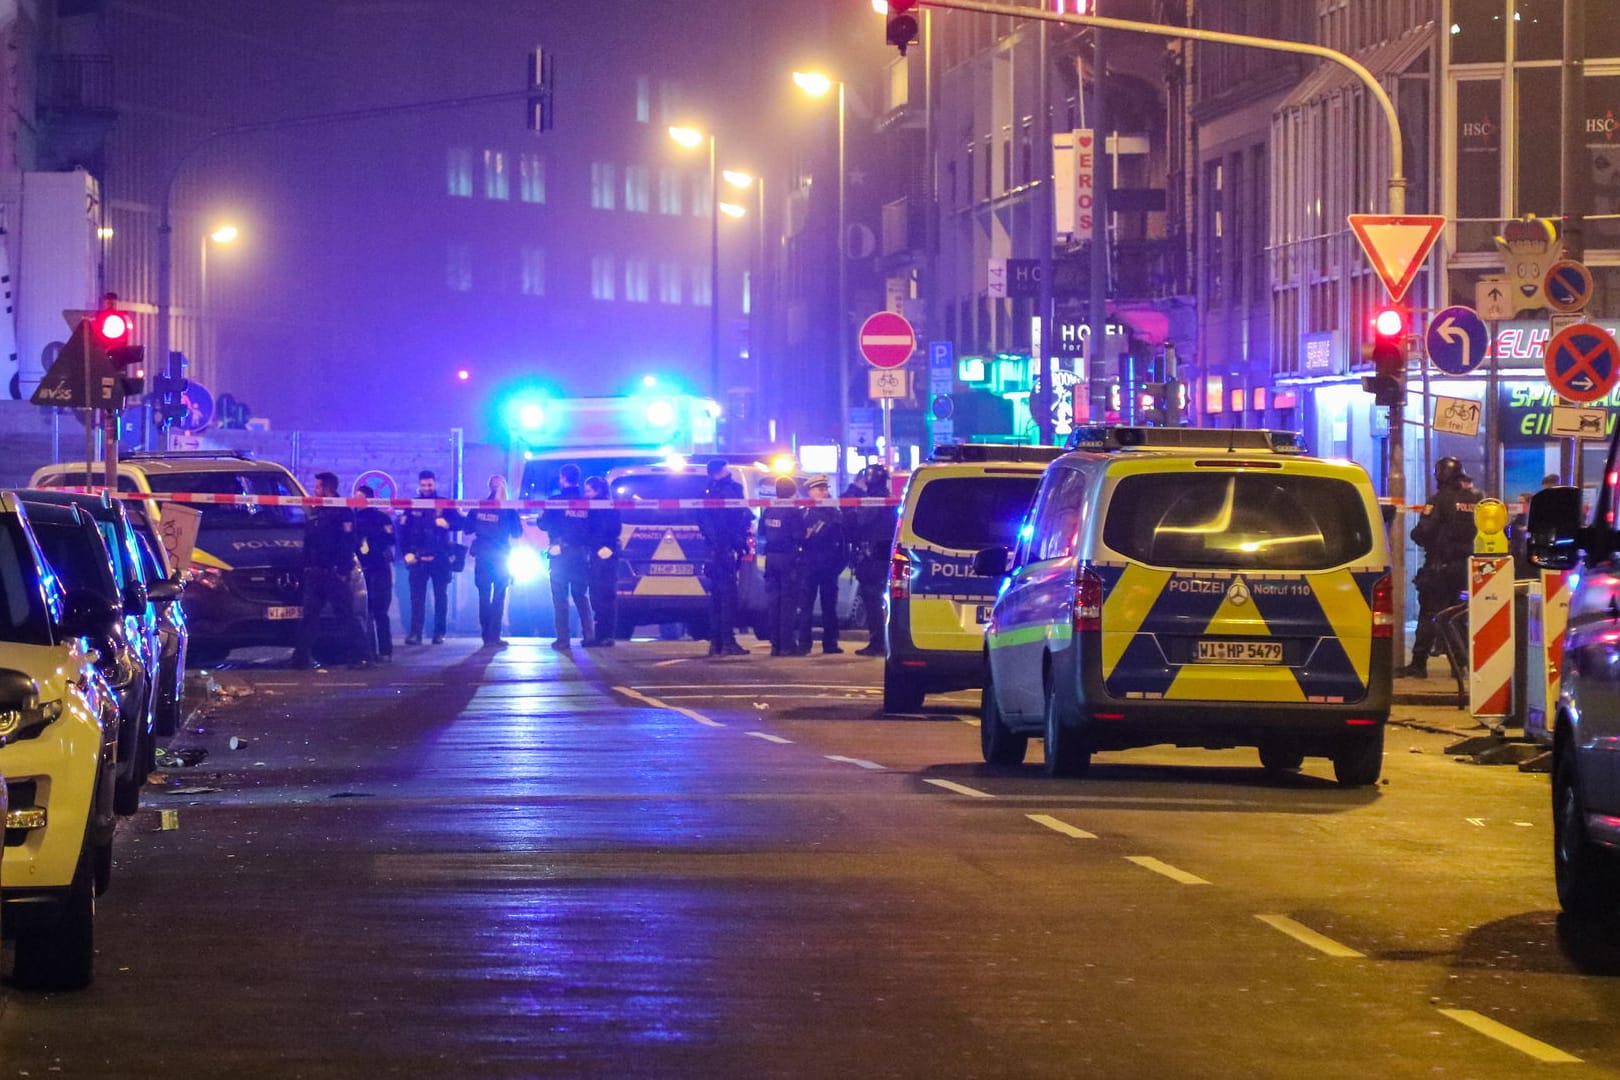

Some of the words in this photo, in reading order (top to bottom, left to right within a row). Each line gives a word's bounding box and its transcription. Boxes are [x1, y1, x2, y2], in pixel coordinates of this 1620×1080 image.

[1463, 123, 1491, 136] HSC
[1587, 118, 1614, 132] HSC
[1078, 153, 1093, 230] EROS
[1455, 502, 1475, 512] POLIZ
[232, 540, 304, 551] POLIZE
[931, 563, 978, 577] POLIZ
[1169, 580, 1225, 593] POLIZEI
[1253, 584, 1287, 595] Notruf
[1291, 585, 1311, 595] 110
[1200, 642, 1218, 658] WI
[1227, 644, 1244, 658] HP
[1248, 644, 1281, 658] 5479
